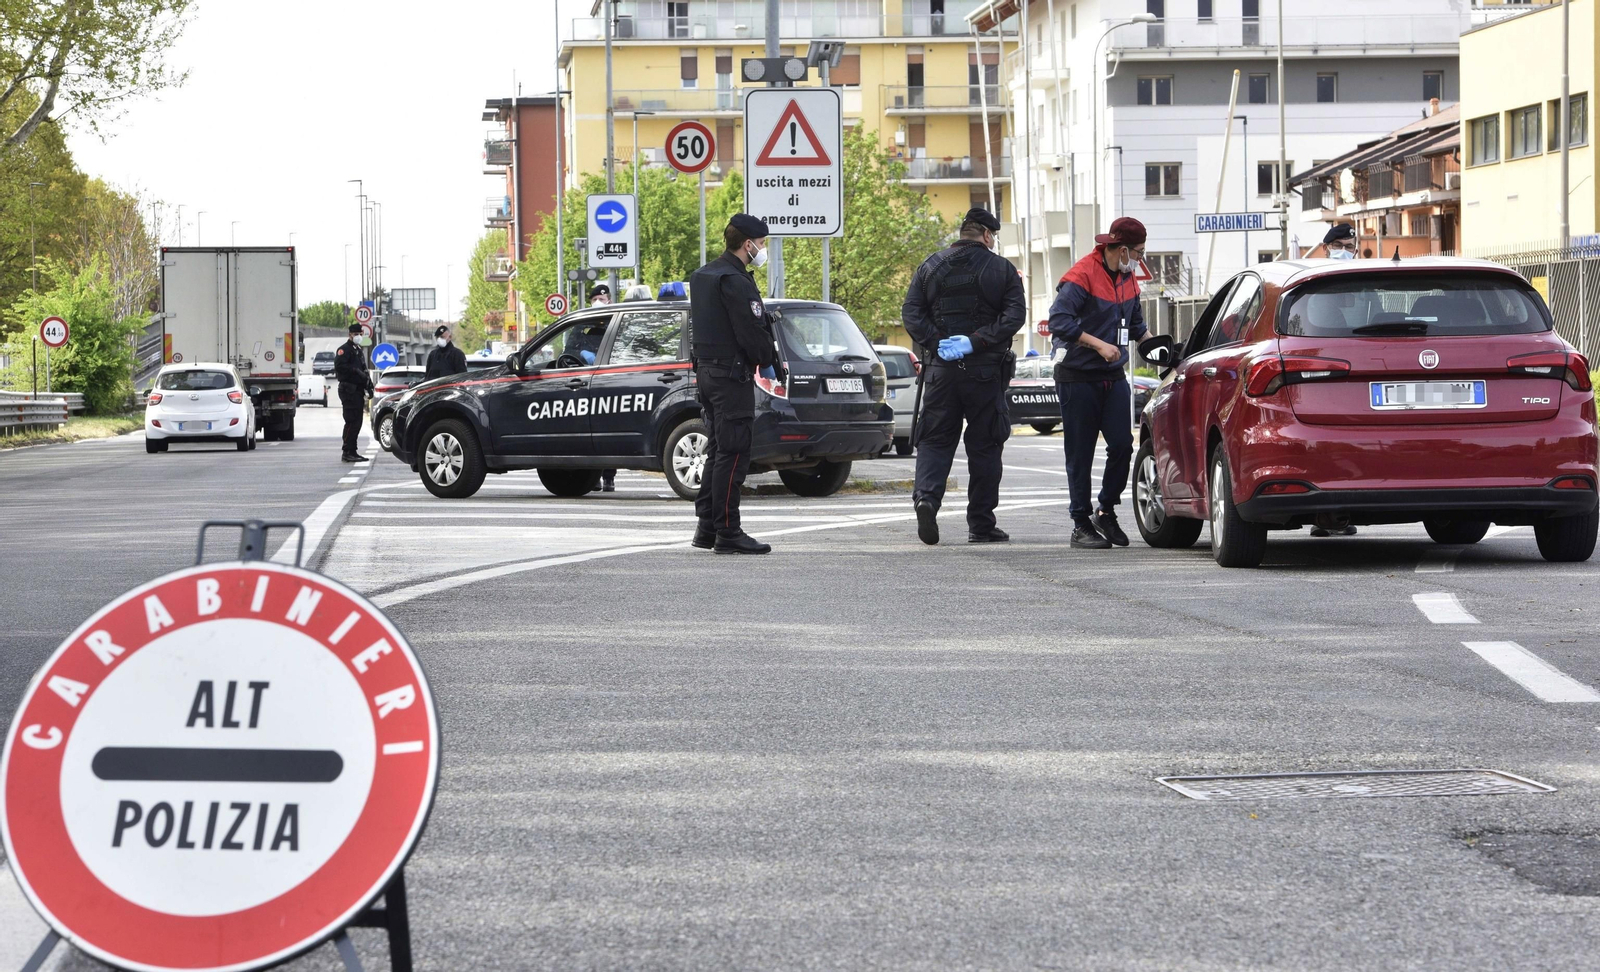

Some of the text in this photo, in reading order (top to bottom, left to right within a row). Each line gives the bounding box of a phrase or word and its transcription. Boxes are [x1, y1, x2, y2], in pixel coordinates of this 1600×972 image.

[676, 135, 704, 160] 50
[756, 175, 831, 187] uscita mezzi
[788, 194, 799, 206] di
[761, 215, 826, 228] emergenza
[1198, 214, 1262, 231] CARABINIERI
[609, 244, 623, 253] 44t
[550, 299, 563, 310] 50
[359, 310, 368, 319] 70
[1423, 354, 1435, 364] FIAT
[1011, 394, 1060, 404] CARABINIE
[527, 393, 654, 420] CARABINIERI
[21, 575, 424, 755] CARABINIERI
[185, 680, 270, 729] ALT
[110, 800, 300, 852] POLIZIA
